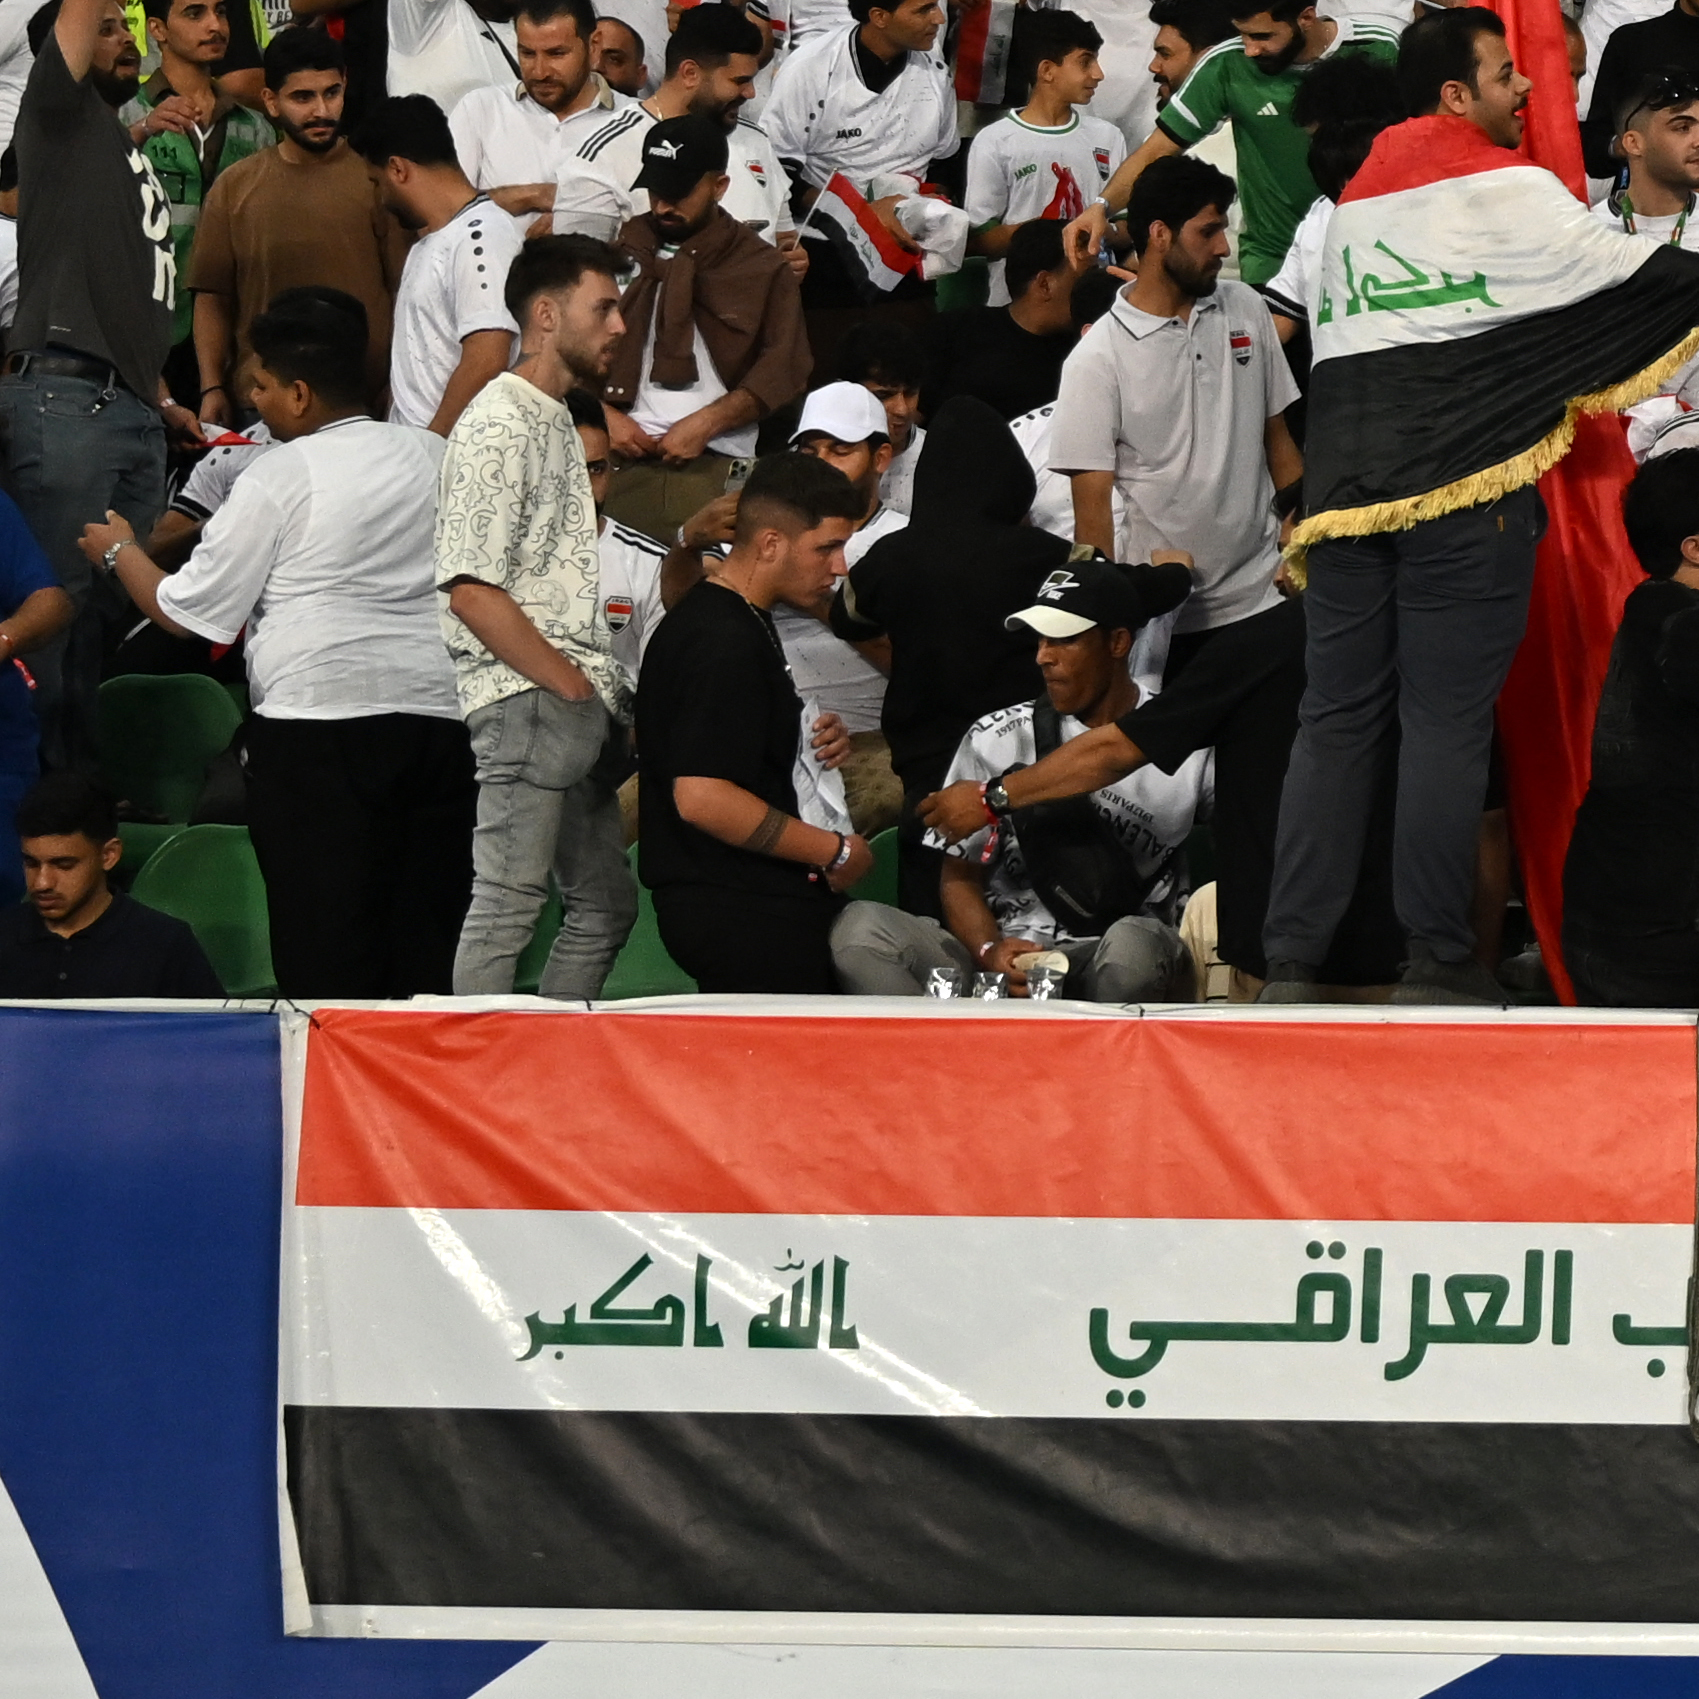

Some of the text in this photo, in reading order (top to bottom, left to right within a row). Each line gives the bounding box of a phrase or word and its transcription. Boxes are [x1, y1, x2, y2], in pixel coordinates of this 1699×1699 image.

[836, 128, 862, 139] JAKO
[1014, 163, 1037, 181] JAKO
[514, 1247, 860, 1361] الله اكبر
[1089, 1241, 1572, 1410] العراقي
